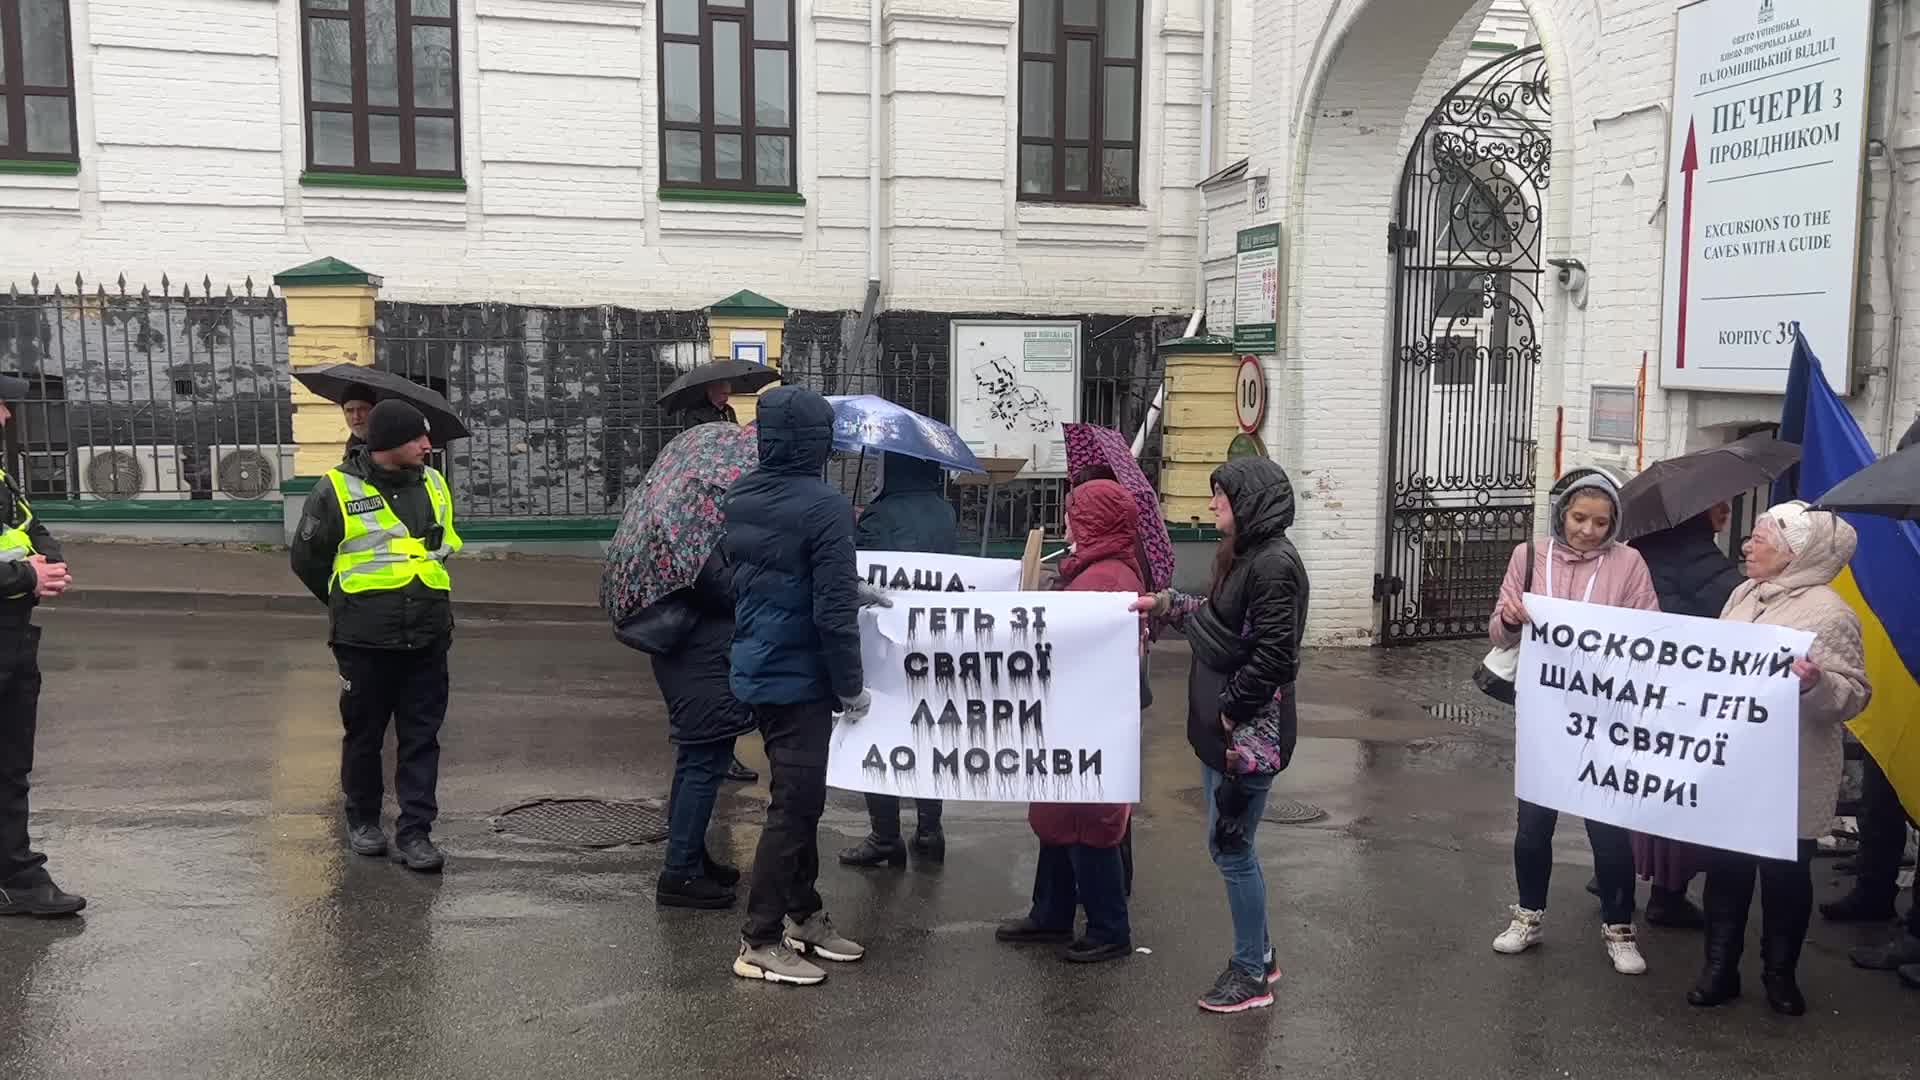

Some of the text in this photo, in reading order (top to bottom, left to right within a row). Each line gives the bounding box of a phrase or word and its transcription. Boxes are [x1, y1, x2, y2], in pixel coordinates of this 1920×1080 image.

[1700, 37, 1836, 85] ПАЛОМНИЦЬКИЙ ВІДДІЛ
[1712, 80, 1824, 134] ПЕЧЕРИ
[1710, 121, 1841, 164] ПРОВІДНИКОМ
[1704, 210, 1831, 238] EXCURSIONS TO THE
[1704, 234, 1832, 260] CAVES WITH A GUIDE
[1718, 320, 1798, 345] КОРПУС 39
[1243, 379, 1257, 409] 10
[907, 606, 1047, 635] ГЕТЬ ЗІ
[903, 642, 1053, 687] СВЯТОЇ
[1531, 622, 1795, 678] МОСКОВСЬКИЙ
[1539, 663, 1668, 710] ШАМАН
[1700, 692, 1769, 724] ГЕТЬ
[910, 698, 1044, 736] ЛАВРИ
[1566, 711, 1729, 766] ЗІ СВЯТОЇ
[861, 743, 1103, 783] ДО МОСКВИ
[1578, 759, 1699, 808] ЛАВРИ!
